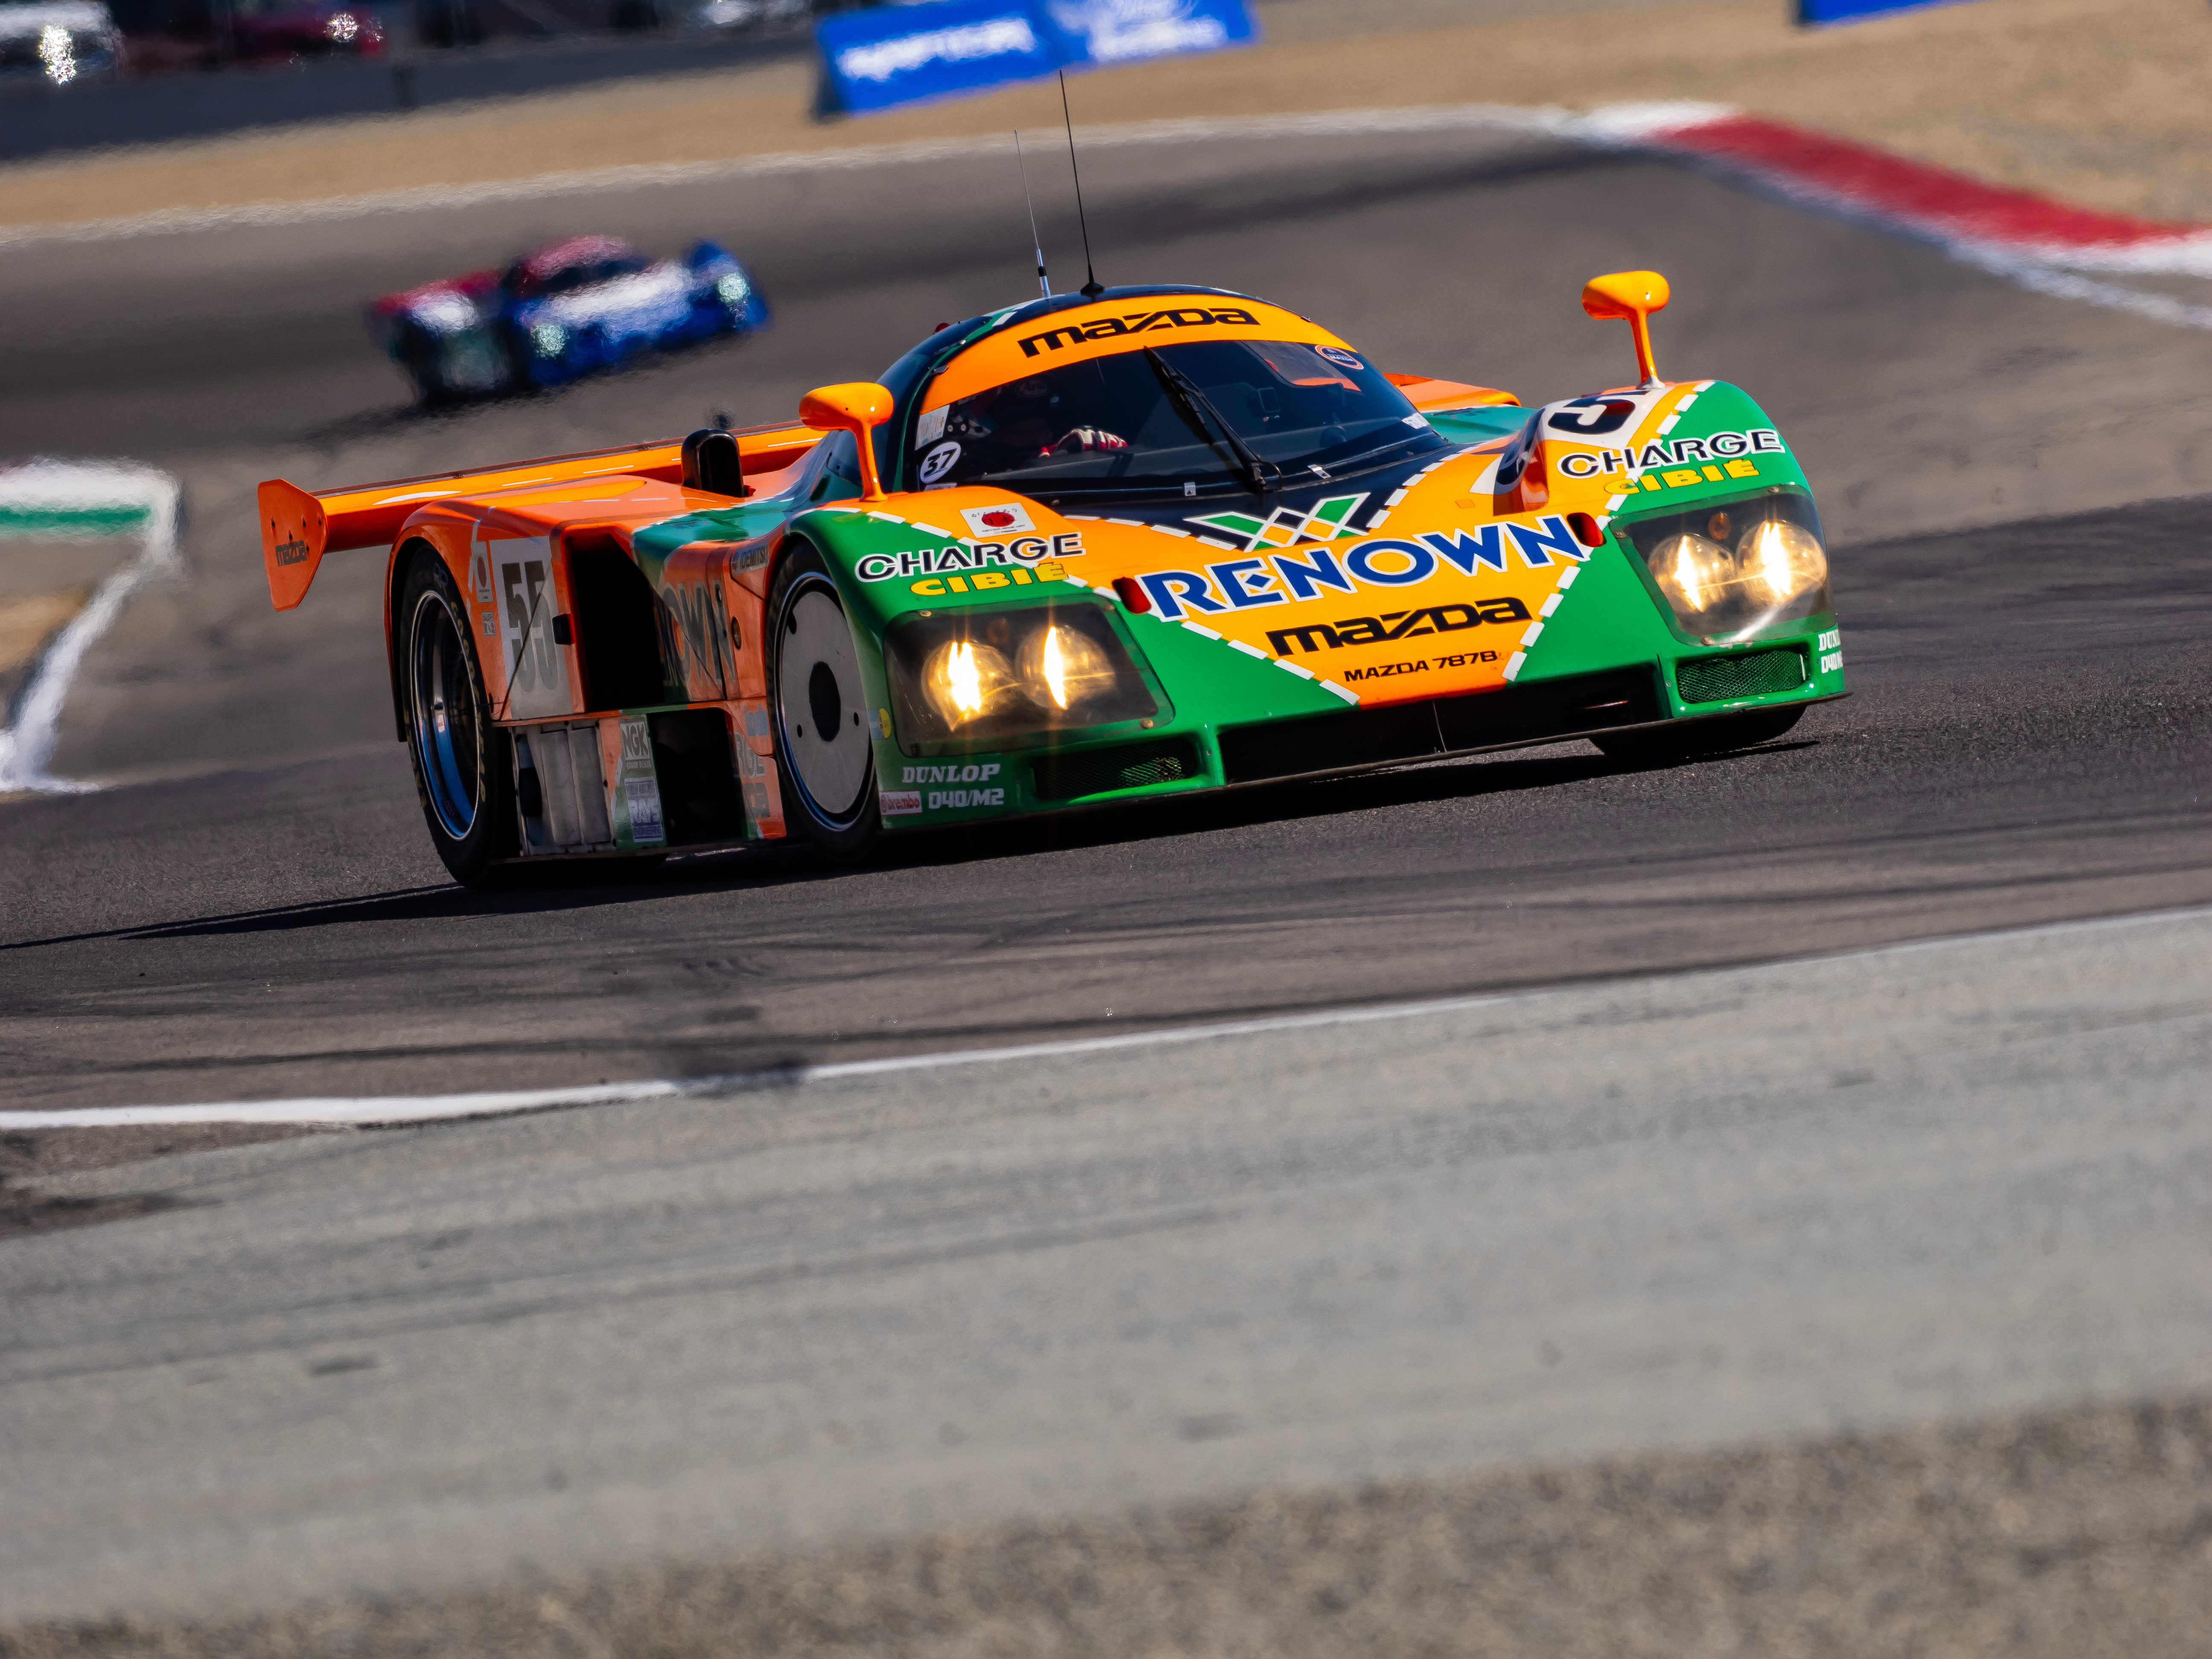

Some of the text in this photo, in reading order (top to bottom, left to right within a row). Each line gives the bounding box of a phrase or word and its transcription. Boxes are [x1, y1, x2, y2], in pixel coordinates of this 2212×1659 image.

[1017, 307, 1260, 358] mazda
[923, 448, 958, 477] 37
[1557, 428, 1785, 478] CHARGE
[1604, 458, 1761, 495] CIBIÉ
[855, 532, 1086, 582] CHARGE
[1134, 512, 1590, 623] RENOWN
[910, 562, 1068, 596] CIBIÉ
[502, 560, 557, 692] 55
[1265, 597, 1533, 657] mazda
[1818, 629, 1841, 652] DUN
[1343, 650, 1499, 682] MAZDA 787B
[621, 725, 650, 758] NGK
[902, 764, 1001, 783] DUNLOP
[928, 788, 1004, 809] D40/M2
